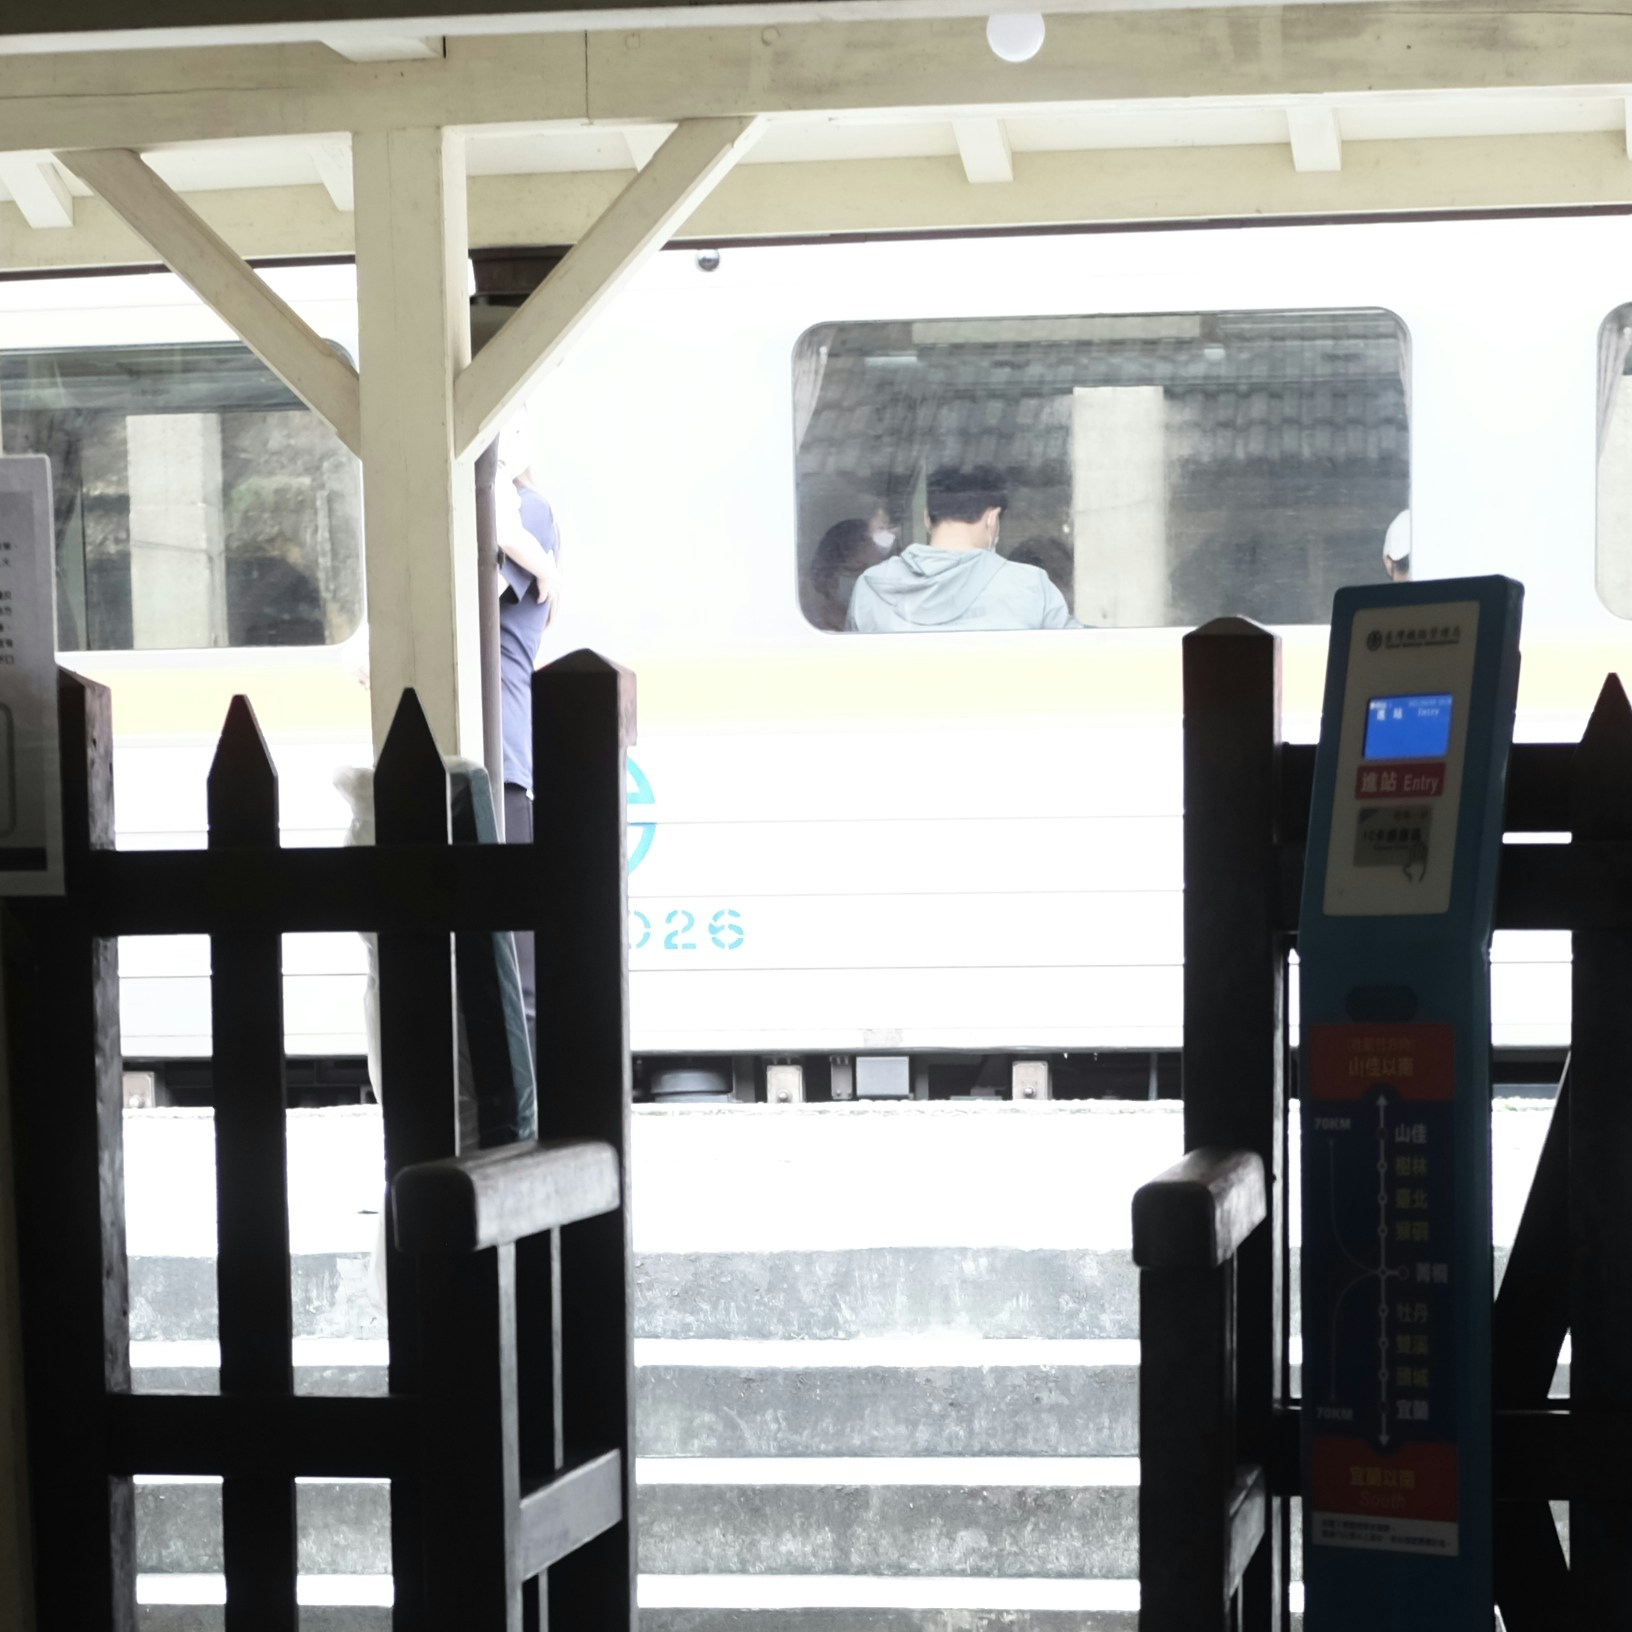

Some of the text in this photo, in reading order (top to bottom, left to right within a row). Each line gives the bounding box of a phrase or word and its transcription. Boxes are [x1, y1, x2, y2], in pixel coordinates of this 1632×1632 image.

[1361, 770, 1440, 795] 進站 Entry
[1313, 1117, 1352, 1131] 70KM
[1394, 1122, 1428, 1144] 山佳
[1315, 1406, 1354, 1421] 70KM
[1359, 1490, 1407, 1511] South
